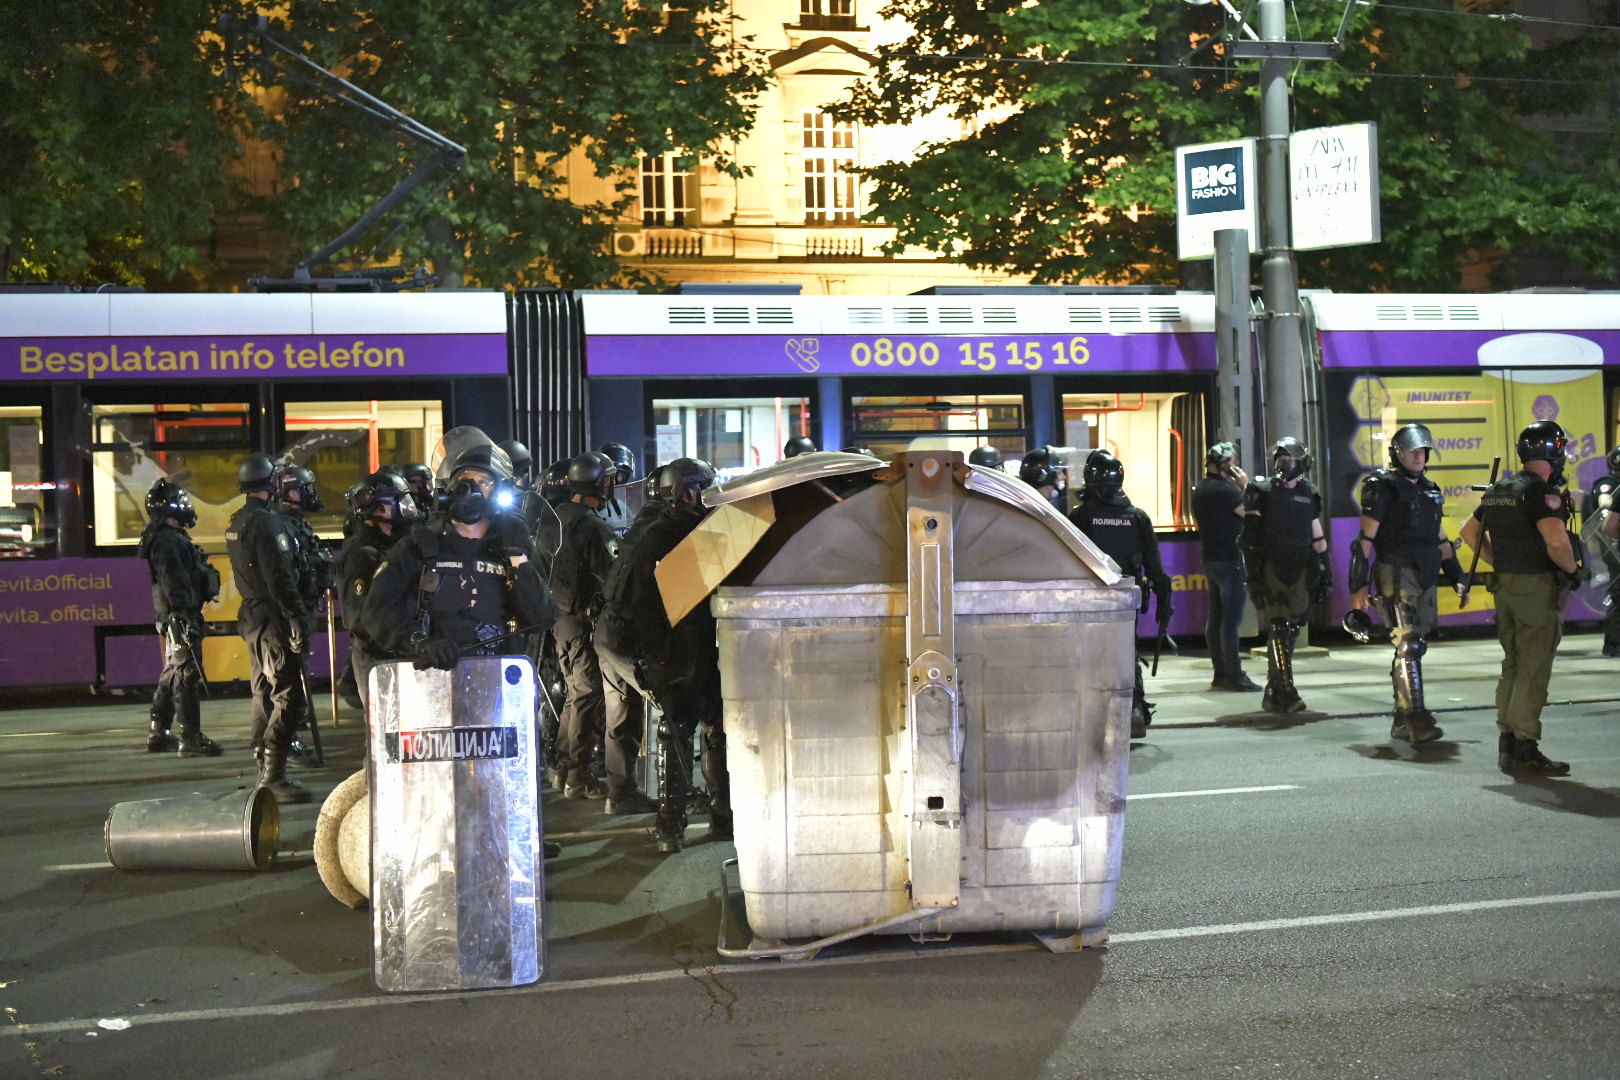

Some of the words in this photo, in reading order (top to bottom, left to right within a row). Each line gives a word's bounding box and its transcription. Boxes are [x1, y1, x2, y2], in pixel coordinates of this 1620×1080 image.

[1191, 164, 1237, 190] BIG
[1192, 185, 1237, 200] FASHION
[20, 345, 200, 379] Besplatan
[210, 343, 275, 370] info
[284, 341, 405, 369] telefon
[851, 337, 940, 367] 0800
[959, 342, 997, 371] 15
[1006, 341, 1043, 371] 15
[1052, 336, 1090, 365] 16
[1407, 391, 1472, 402] IMUNITET
[1437, 437, 1483, 450] RNOST
[1092, 517, 1131, 527] ПОЛИЦИЈА
[401, 731, 501, 761] ПОЛИЦИЈА
